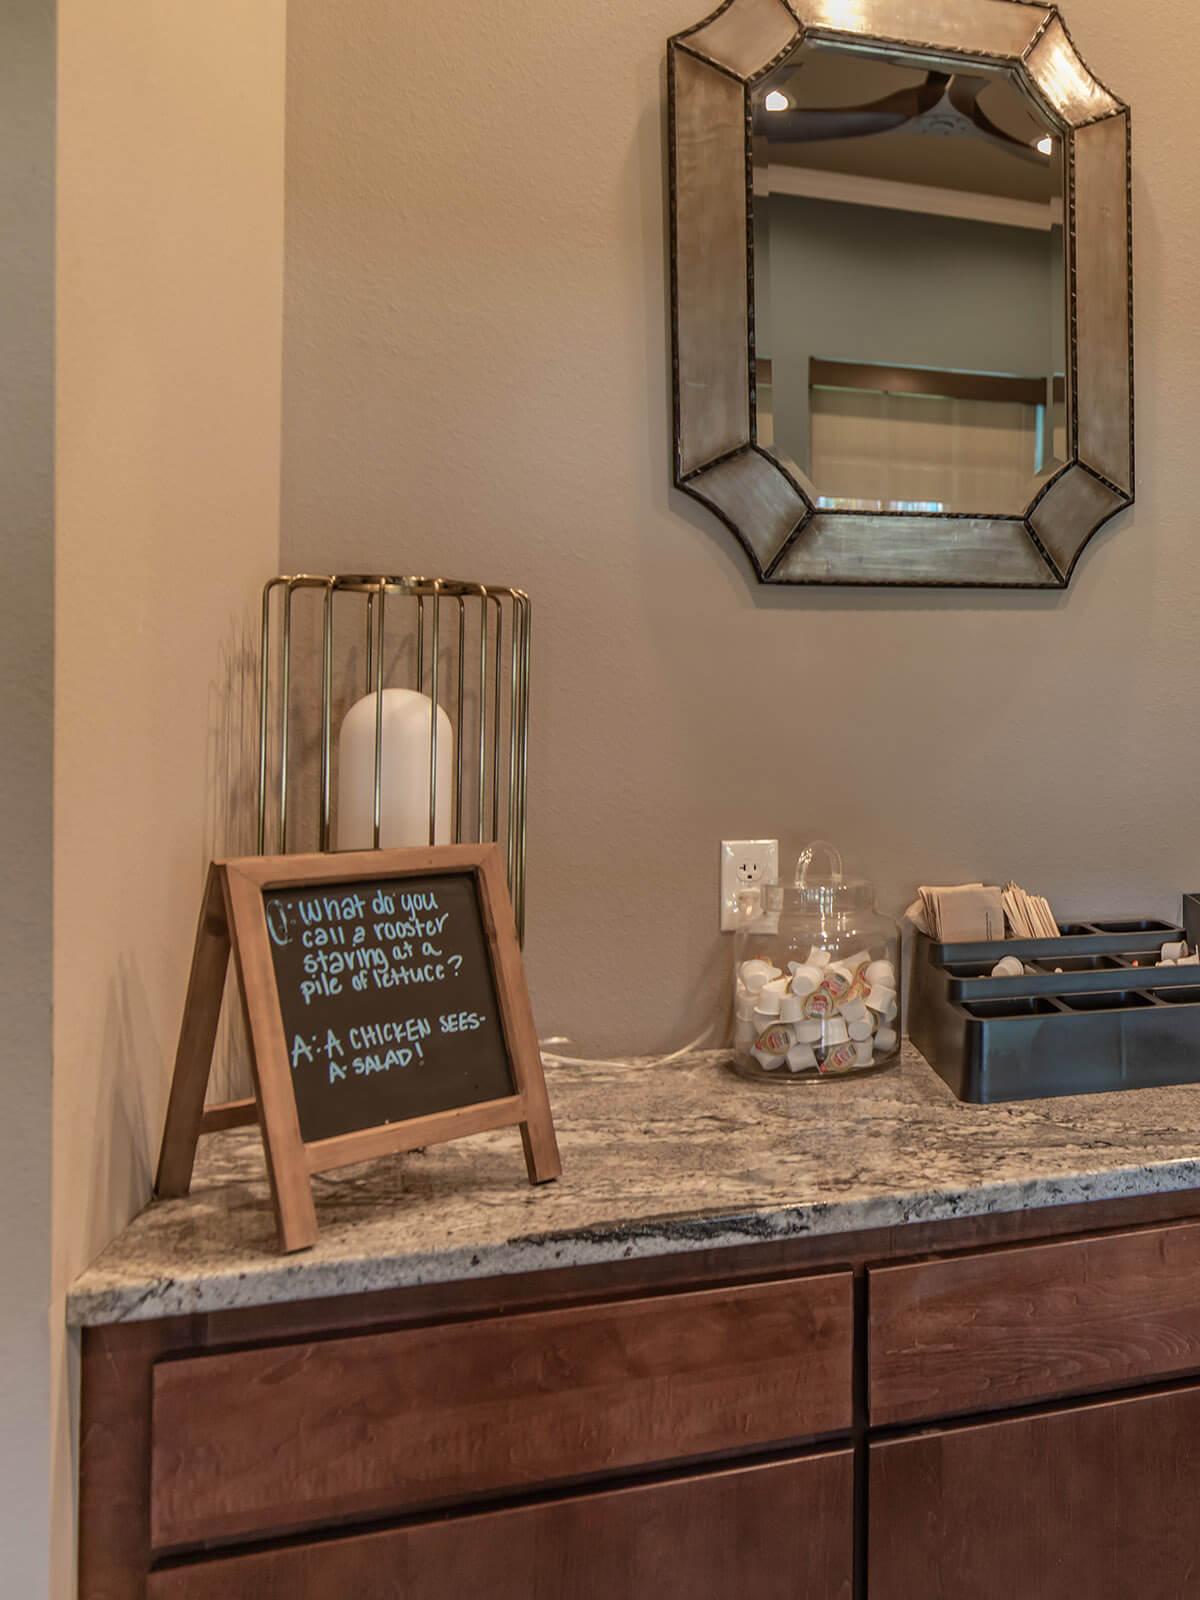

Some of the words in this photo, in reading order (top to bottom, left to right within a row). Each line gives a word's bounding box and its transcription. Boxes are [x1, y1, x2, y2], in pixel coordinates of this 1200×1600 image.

[299, 894, 366, 925] What
[372, 889, 396, 915] do
[401, 891, 438, 921] you
[302, 926, 346, 948] call
[352, 926, 366, 947] a
[374, 912, 449, 942] rooster
[392, 941, 414, 961] at
[422, 942, 442, 957] a
[300, 972, 344, 1005] pile
[352, 970, 370, 992] of
[291, 1034, 322, 1069] A:
[324, 1029, 345, 1059] A
[349, 1018, 431, 1050] CHICKEN
[352, 1042, 425, 1076] SALAD!
